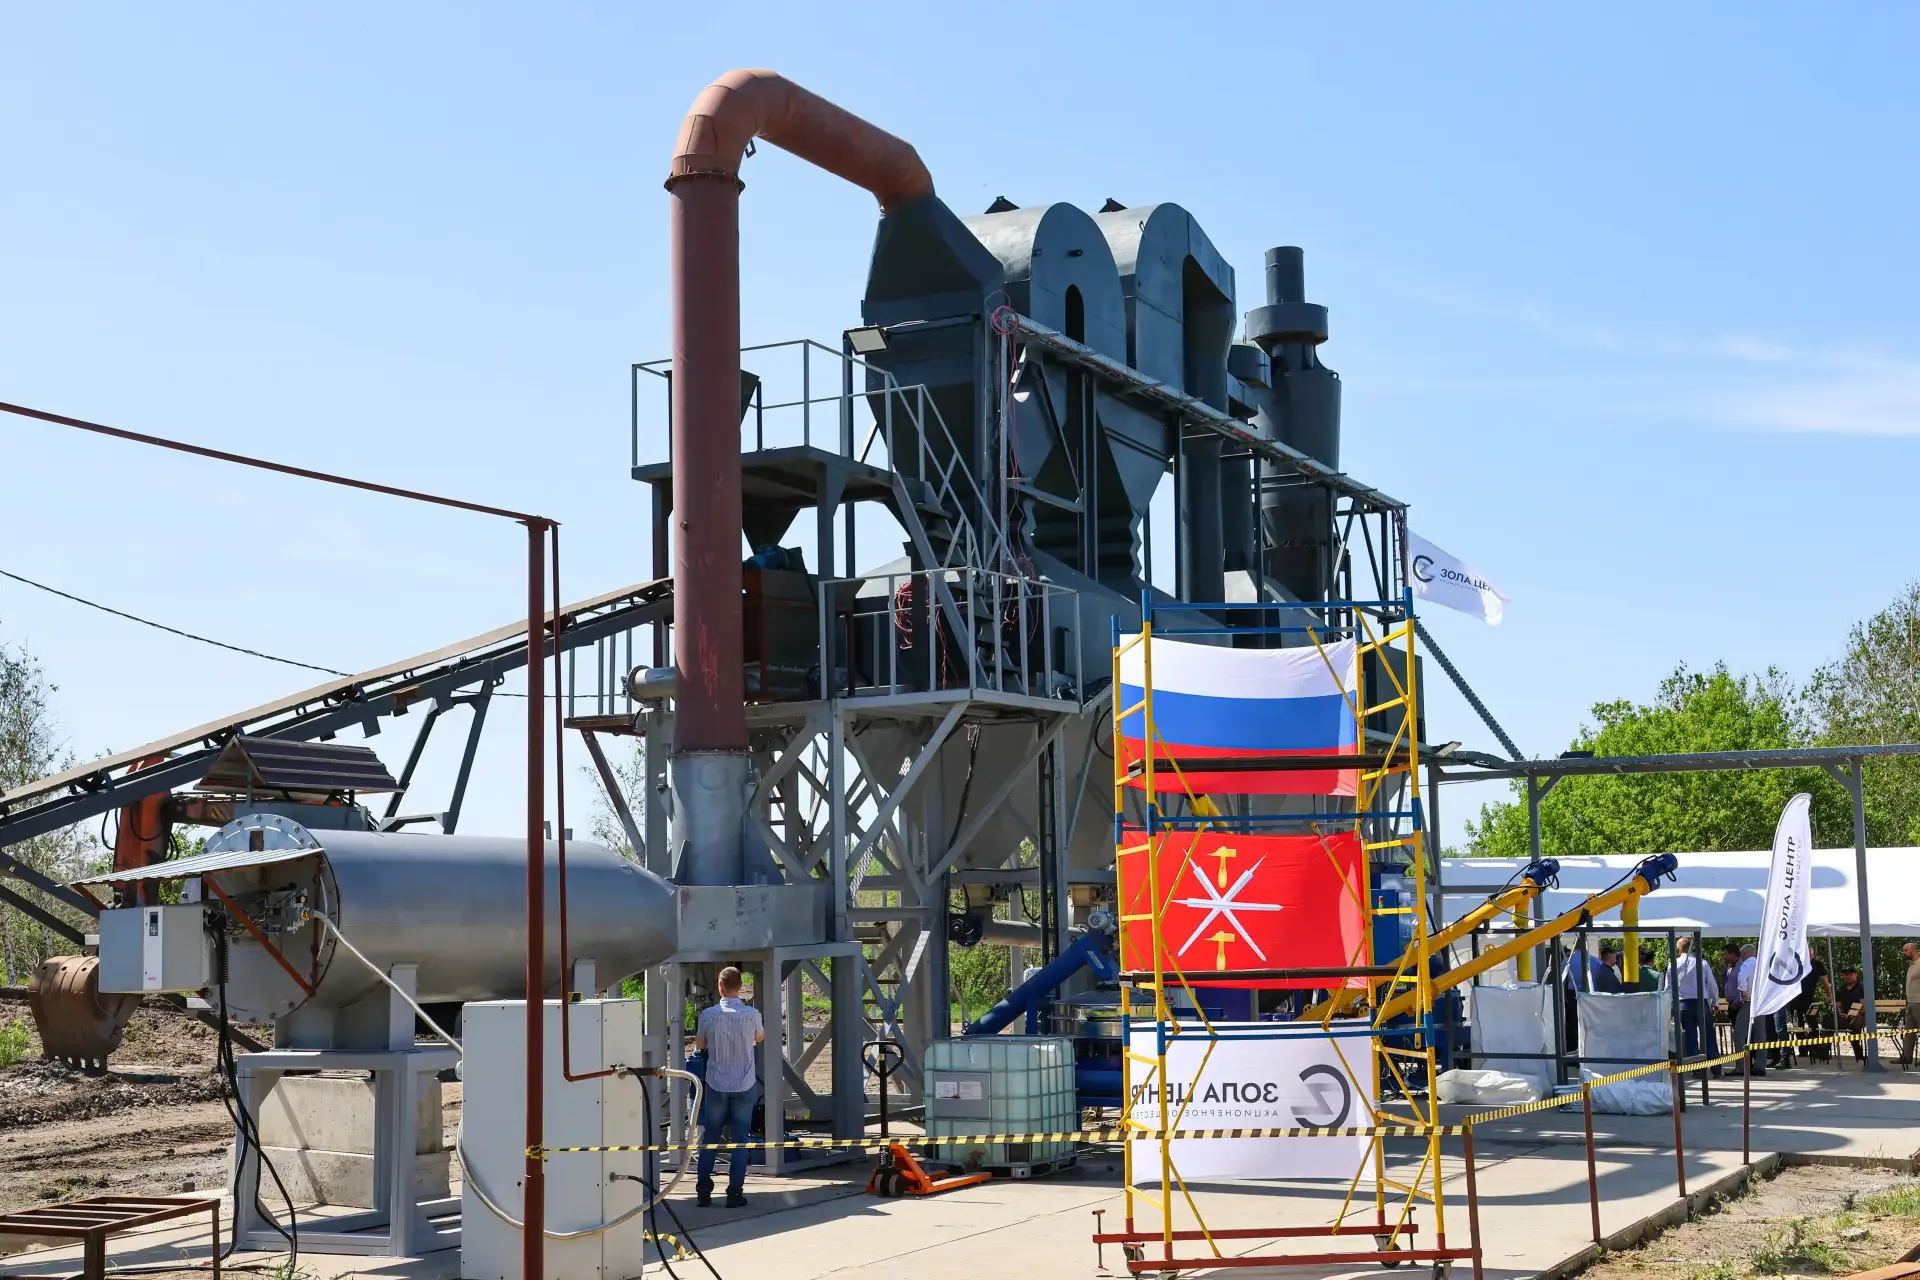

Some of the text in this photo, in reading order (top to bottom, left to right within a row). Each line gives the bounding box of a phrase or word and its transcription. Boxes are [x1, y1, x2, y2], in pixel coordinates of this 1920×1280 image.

[1440, 568, 1471, 585] ЗОЛА
[1779, 836, 1796, 940] ЗОЛА ЦЕНТР
